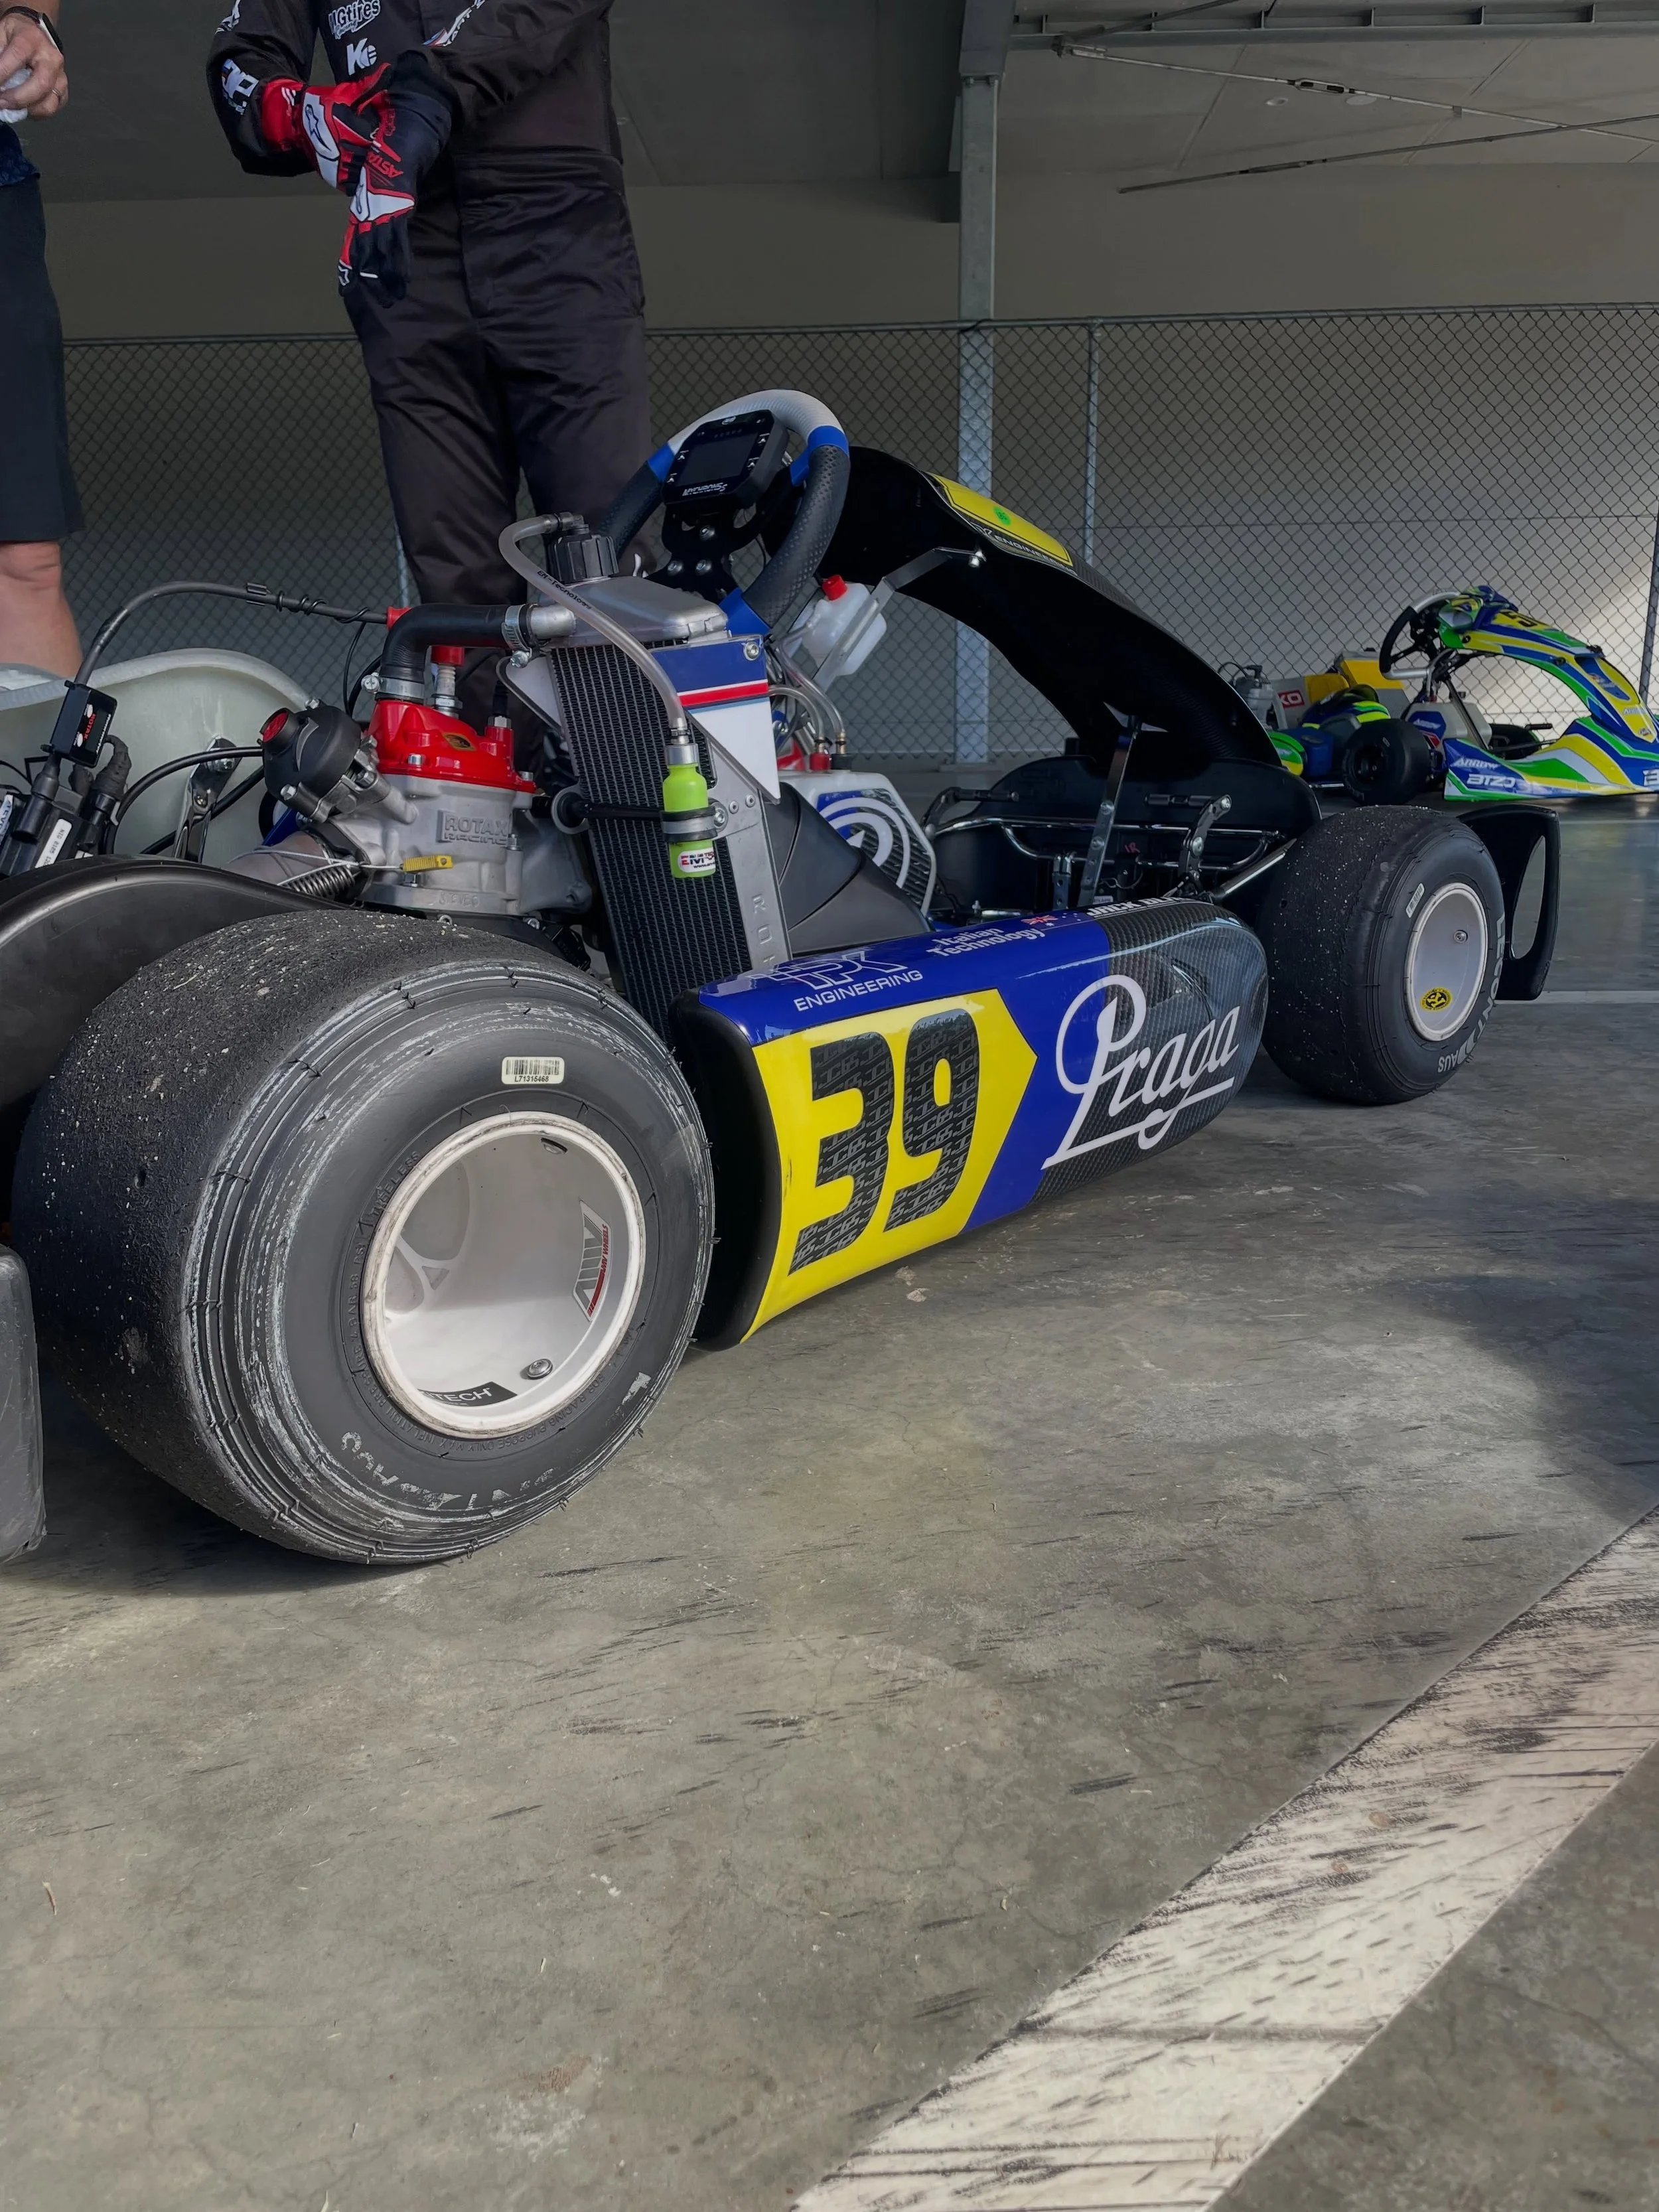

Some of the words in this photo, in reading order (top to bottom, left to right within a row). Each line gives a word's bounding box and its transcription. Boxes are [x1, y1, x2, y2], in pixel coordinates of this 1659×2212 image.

[444, 814, 508, 838] ROTAX
[1086, 901, 1142, 917] JACK
[926, 928, 1046, 956] Technology
[932, 928, 1005, 946] Italian
[793, 970, 924, 1012] ENGINEERING
[1041, 974, 1240, 1170] Praga
[788, 1007, 979, 1276] 39
